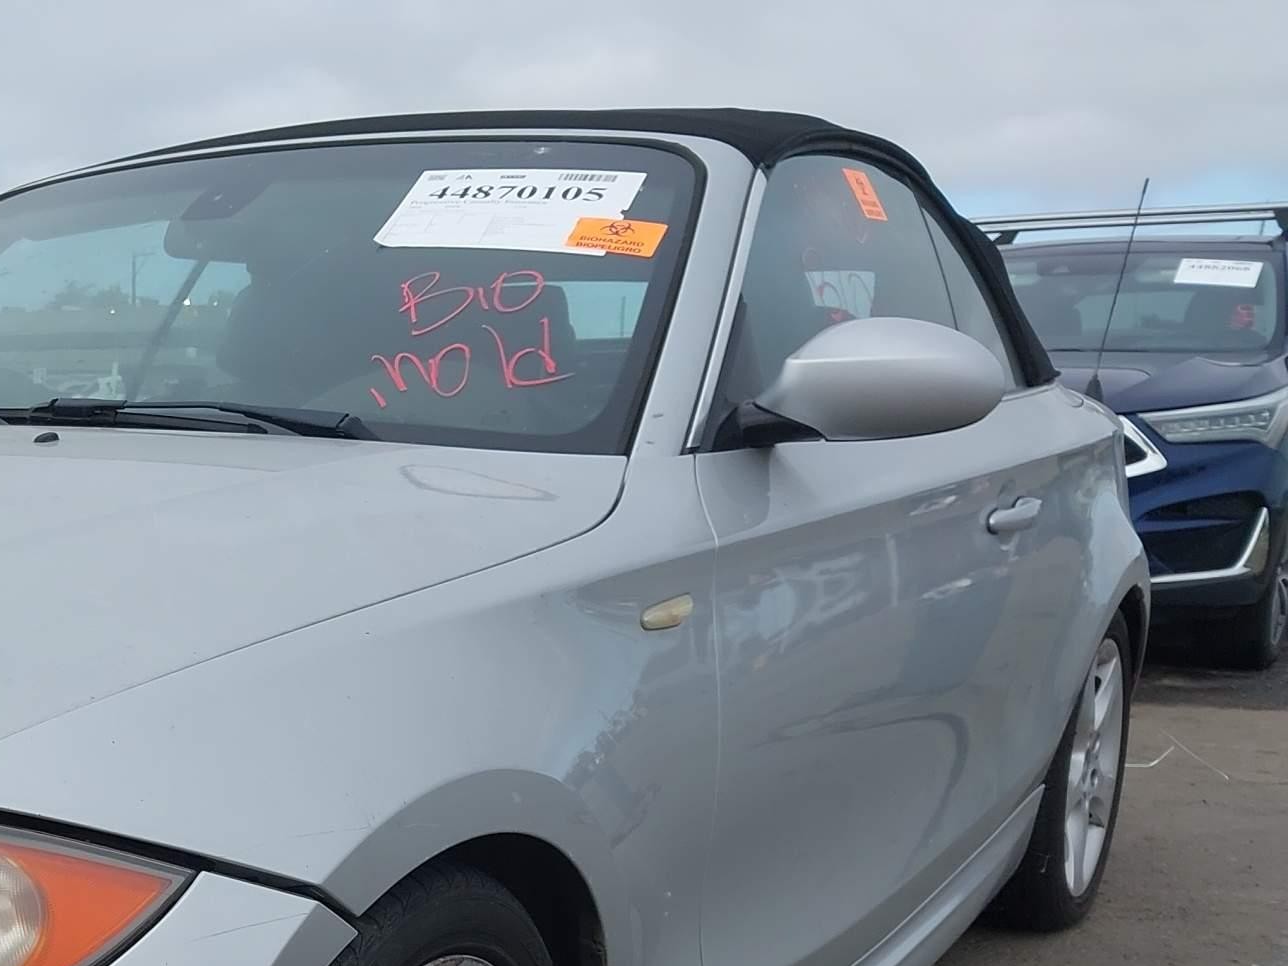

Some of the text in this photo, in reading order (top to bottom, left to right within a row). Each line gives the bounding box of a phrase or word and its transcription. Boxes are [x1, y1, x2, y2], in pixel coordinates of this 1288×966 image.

[429, 185, 608, 202] 44870105
[575, 241, 642, 254] BIOPELIGRO
[579, 235, 645, 247] BIOHAZARD
